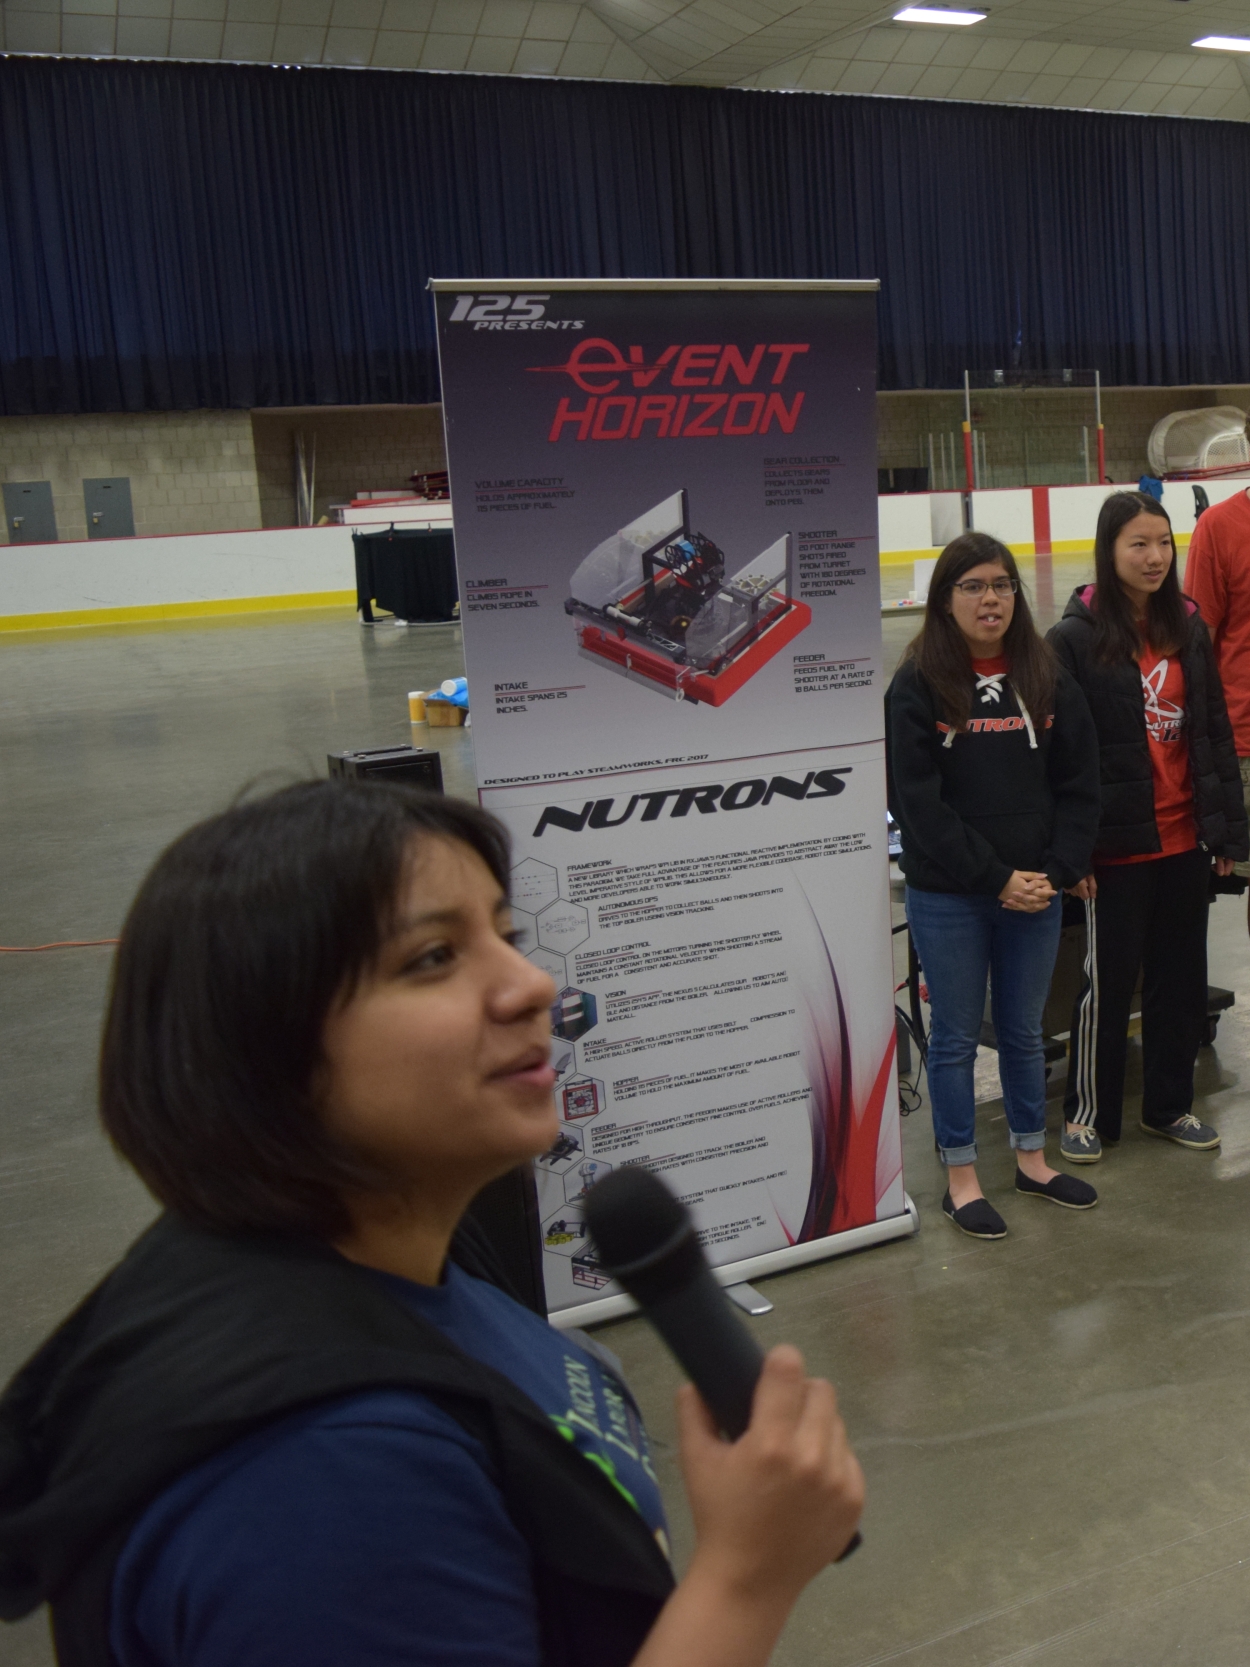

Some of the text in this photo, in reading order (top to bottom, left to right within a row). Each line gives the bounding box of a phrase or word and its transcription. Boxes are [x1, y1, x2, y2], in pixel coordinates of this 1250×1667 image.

[449, 294, 551, 322] 125
[474, 320, 585, 332] PRESENTS
[548, 392, 806, 443] HORIZON
[764, 456, 840, 466] GEAR COLLECTION
[764, 468, 831, 478] COLLECTS GEARS
[475, 478, 564, 490] VOLUME CAPACITY
[788, 479, 813, 487] FLOOR
[815, 478, 830, 486] AND
[476, 490, 575, 502] HOLDS APPROXIMATELY
[765, 489, 801, 497] DEPLOYS
[490, 503, 519, 512] PIECES
[520, 502, 532, 510] OF
[766, 498, 786, 506] ONTO
[798, 530, 837, 539] SHOOTER
[799, 544, 809, 552] 20
[831, 542, 856, 550] RANGE
[800, 552, 825, 561] SHOTS
[800, 562, 820, 570] FROM
[834, 568, 866, 577] DEGREES
[466, 578, 508, 588] CLIMBER
[812, 579, 856, 588] ROTATIONAL
[467, 590, 533, 602] CLIMBS ROPE IN
[468, 600, 539, 612] SEVEN SECONDS.
[794, 654, 826, 663] FEEDER
[794, 667, 818, 675] FEEDS
[794, 675, 829, 684] SHOOTER
[848, 671, 866, 679] RATE
[494, 682, 529, 692] INTAKE
[804, 684, 828, 693] BALLS
[830, 682, 844, 690] PER
[845, 679, 873, 689] SECOND.
[496, 696, 526, 704] INTAKE
[528, 692, 556, 702] SPANS
[496, 705, 529, 714] INCHES.
[484, 774, 541, 785] DESIGNED
[542, 772, 556, 780] TO
[558, 770, 587, 778] PLAY
[587, 760, 663, 774] STEAMWORKS,
[687, 754, 710, 762] 2017
[532, 767, 854, 838] NUTRONS
[573, 874, 587, 882] NEW
[589, 870, 613, 879] LIBRARY
[615, 867, 633, 875] WHICH
[635, 864, 656, 872] WRAPS
[715, 849, 749, 860] FUNCTIONAL
[751, 845, 776, 855] REACTIVE
[832, 834, 851, 842] CODING
[567, 859, 612, 871] FRAMEWORK
[598, 896, 659, 911] AUTONOMOUS OPS
[598, 913, 619, 922] DRIVES
[641, 906, 663, 915] HOPPER
[674, 900, 698, 910] COLLECT
[700, 897, 719, 905] BALLS
[748, 889, 770, 897] SHOOTS
[575, 940, 651, 960] CLOSED LOOP CONTROL
[605, 990, 627, 999] VISION
[583, 1038, 607, 1048] INTAKE
[612, 1076, 639, 1087] HOPPER
[591, 1123, 617, 1134] FEEDER
[620, 1154, 651, 1166] SHOOTER
